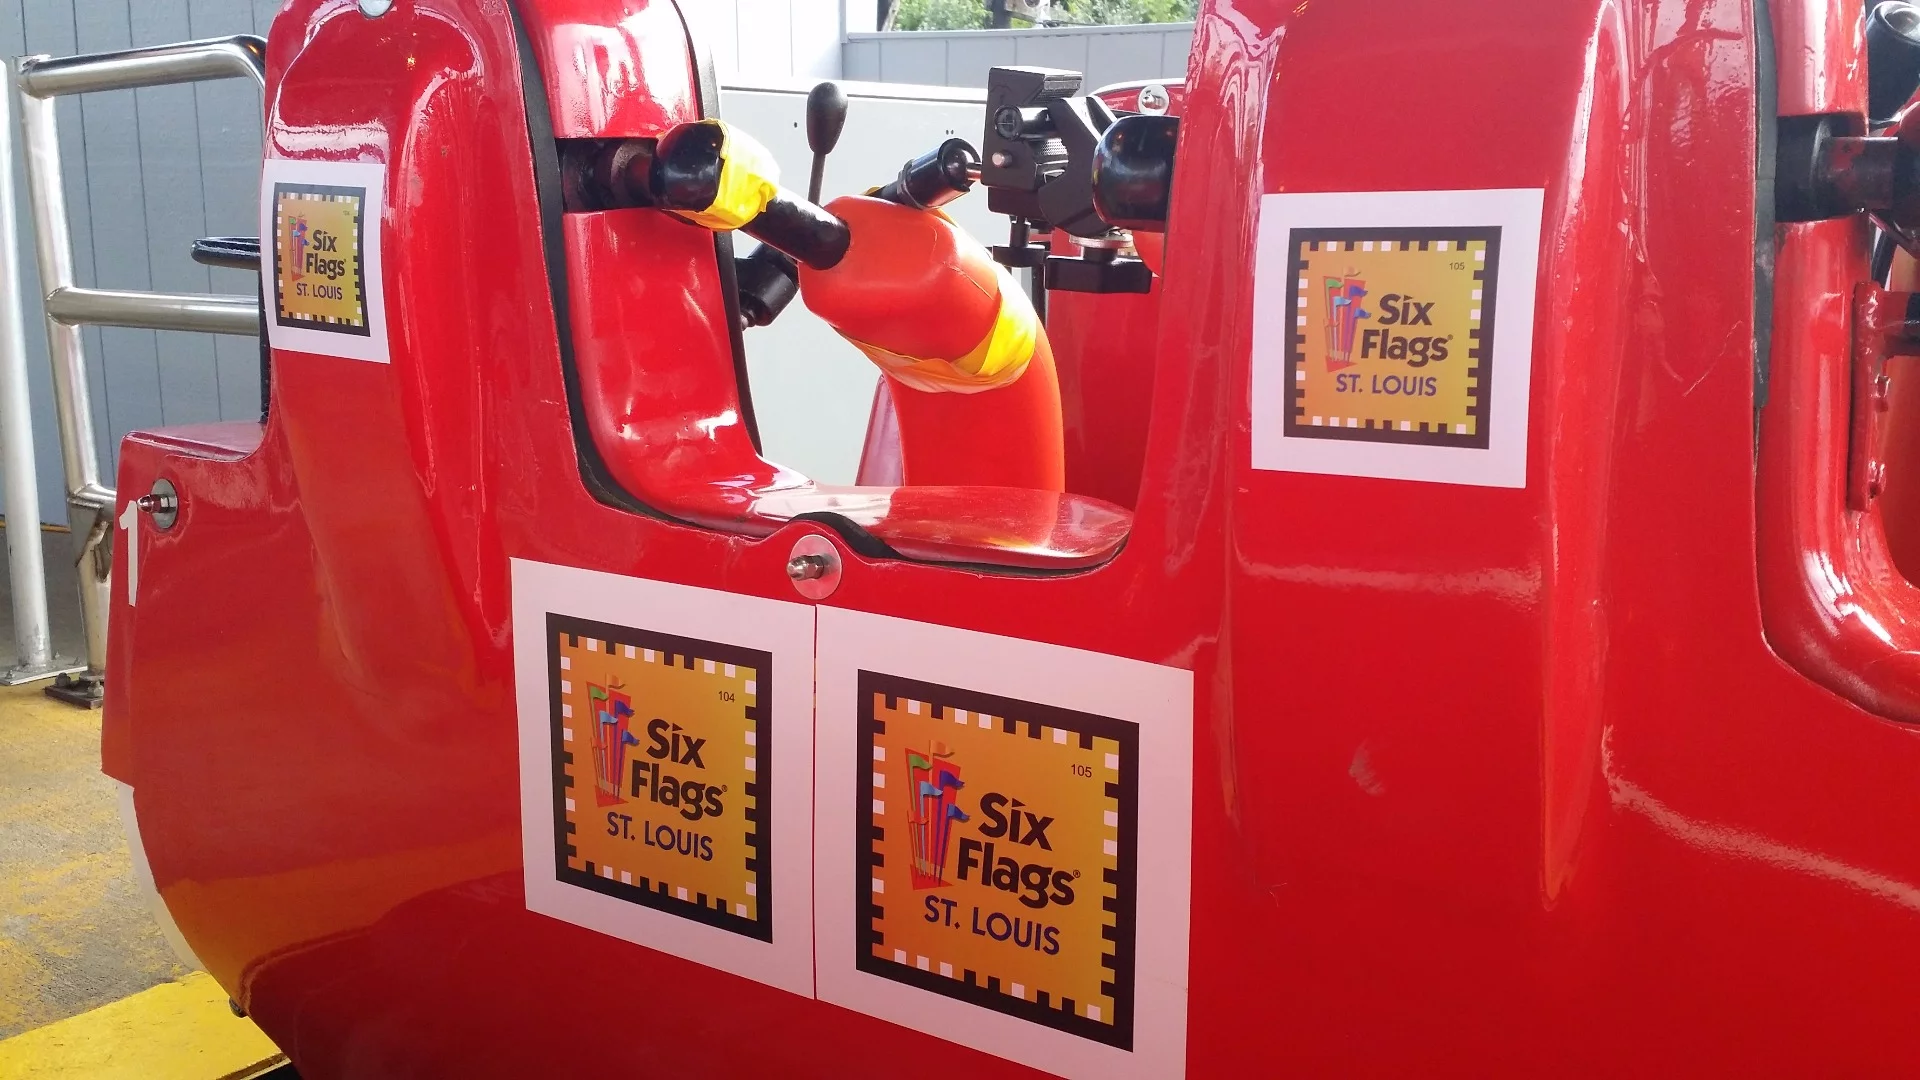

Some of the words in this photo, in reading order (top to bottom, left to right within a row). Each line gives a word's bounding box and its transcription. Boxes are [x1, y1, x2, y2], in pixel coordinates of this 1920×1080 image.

[313, 229, 338, 252] Six
[1449, 262, 1465, 271] 105
[296, 283, 310, 297] ST.
[312, 284, 343, 300] LOUIS
[1377, 293, 1436, 326] Six
[1335, 373, 1363, 393] ST.
[1371, 374, 1437, 397] LOUIS
[118, 500, 138, 607] 1
[718, 690, 735, 703] 104
[646, 718, 707, 770] Six
[1070, 763, 1092, 778] 105
[977, 792, 1055, 852] Six
[606, 811, 636, 841] ST.
[644, 820, 713, 862] LOUIS
[924, 894, 961, 930] ST.
[971, 906, 1061, 955] LOUIS
